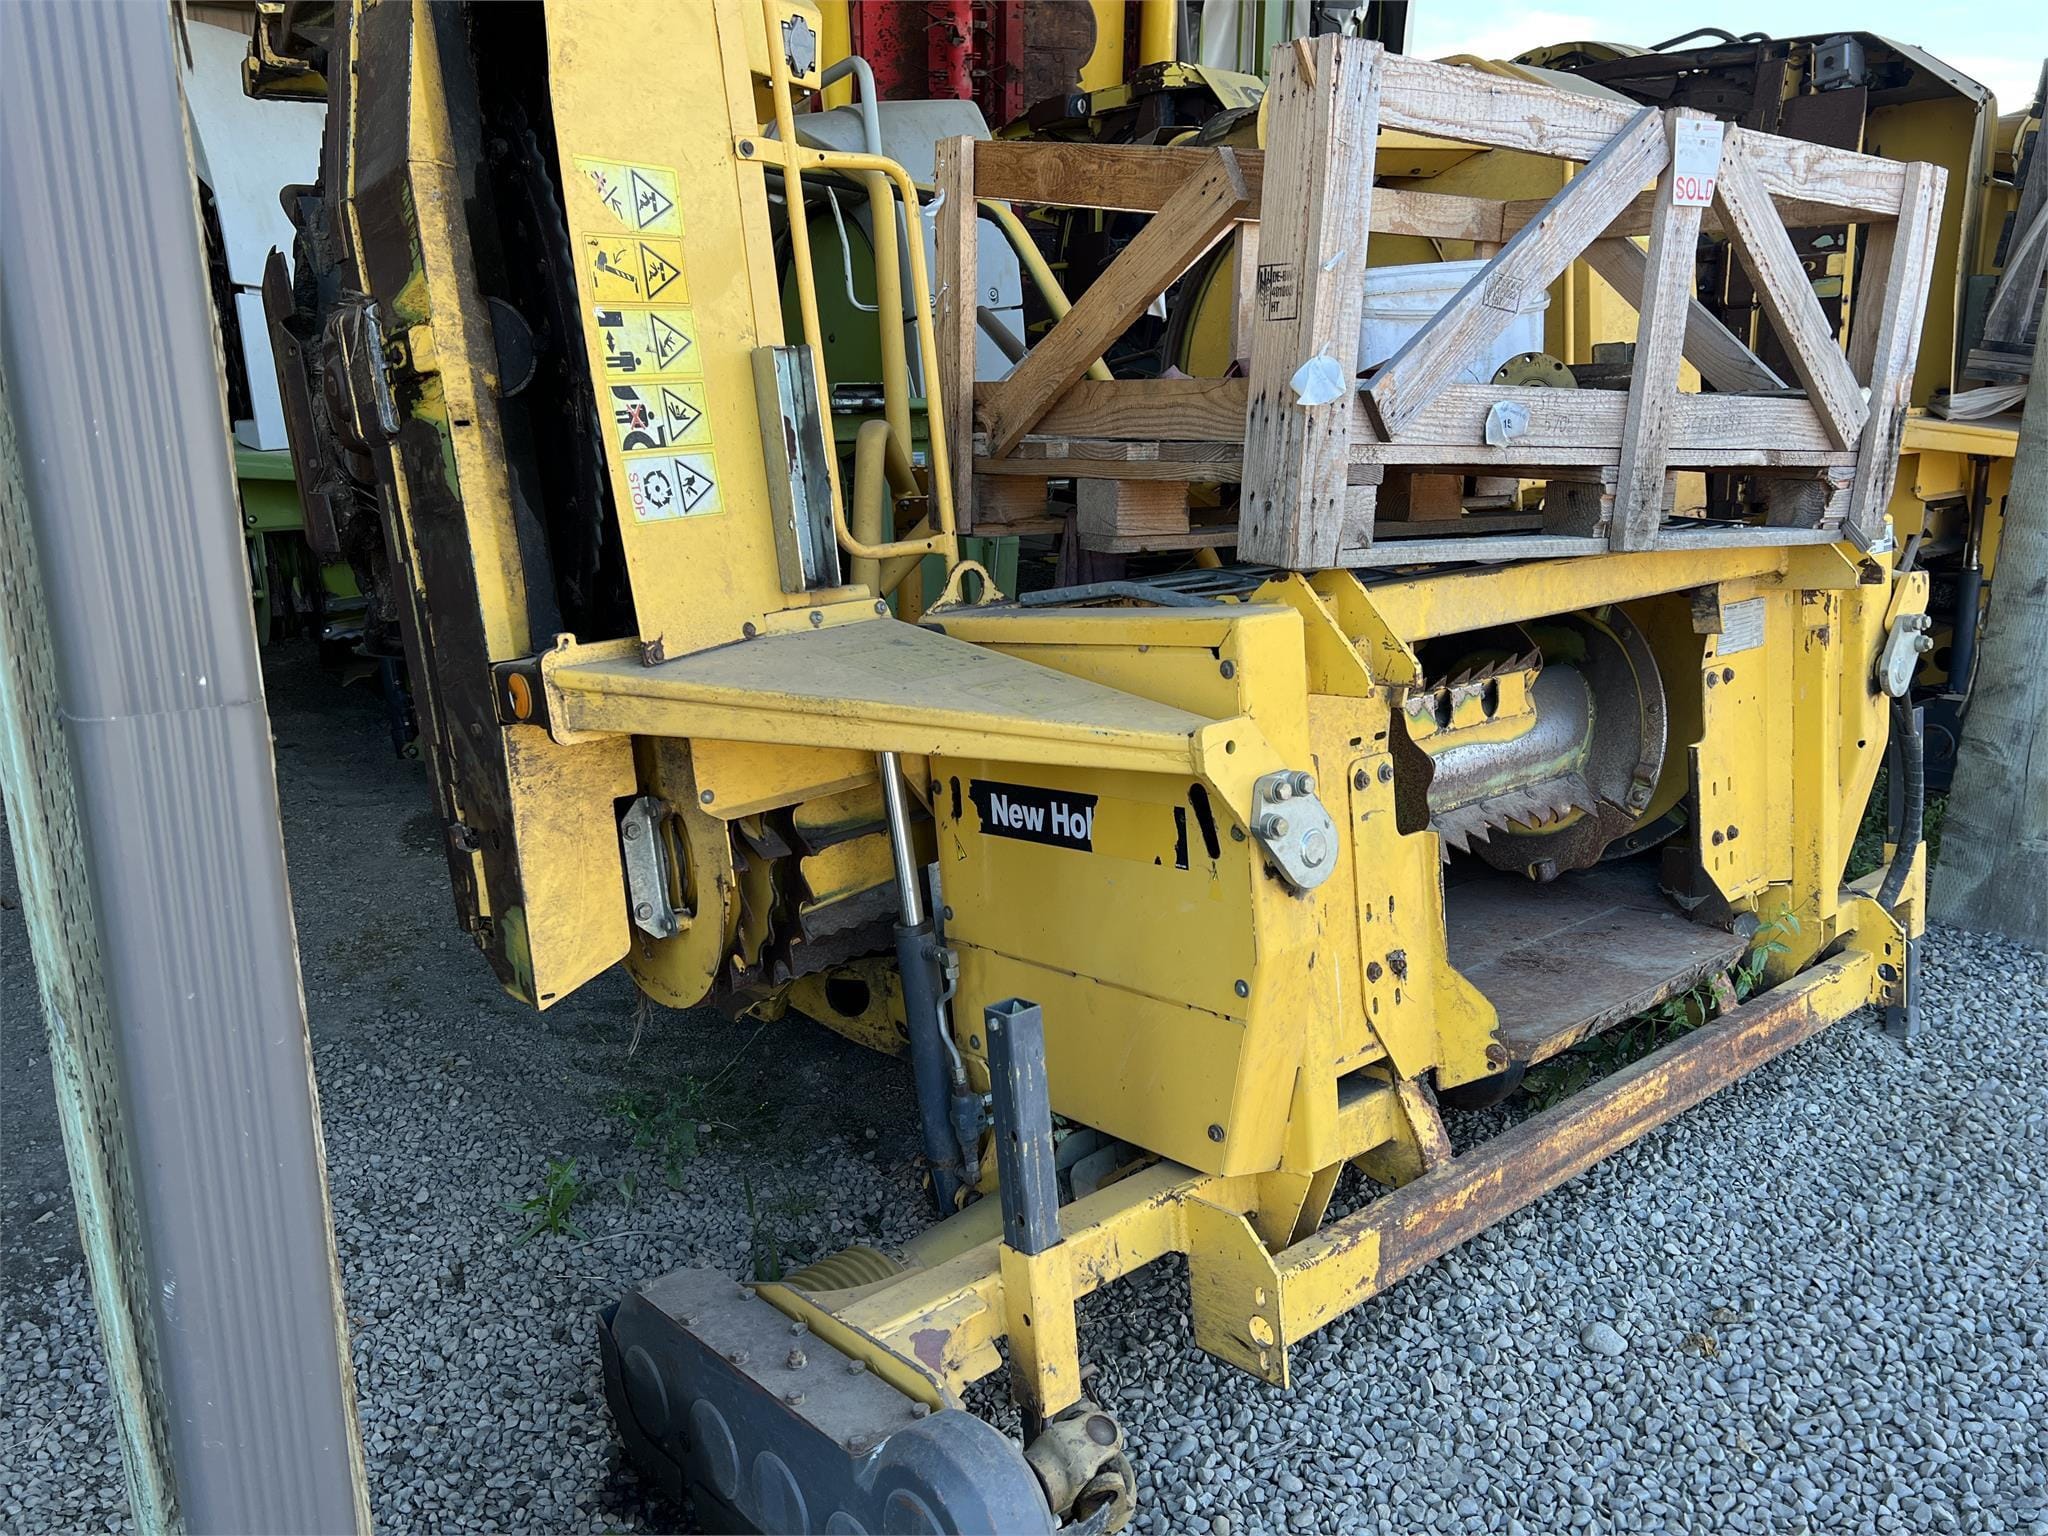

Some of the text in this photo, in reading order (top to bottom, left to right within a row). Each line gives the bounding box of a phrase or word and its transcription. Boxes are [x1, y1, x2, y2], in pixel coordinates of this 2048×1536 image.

[1675, 176, 1714, 201] SOLD
[1270, 301, 1280, 313] HT
[628, 472, 646, 516] STOP
[990, 792, 1093, 841] New Hol
